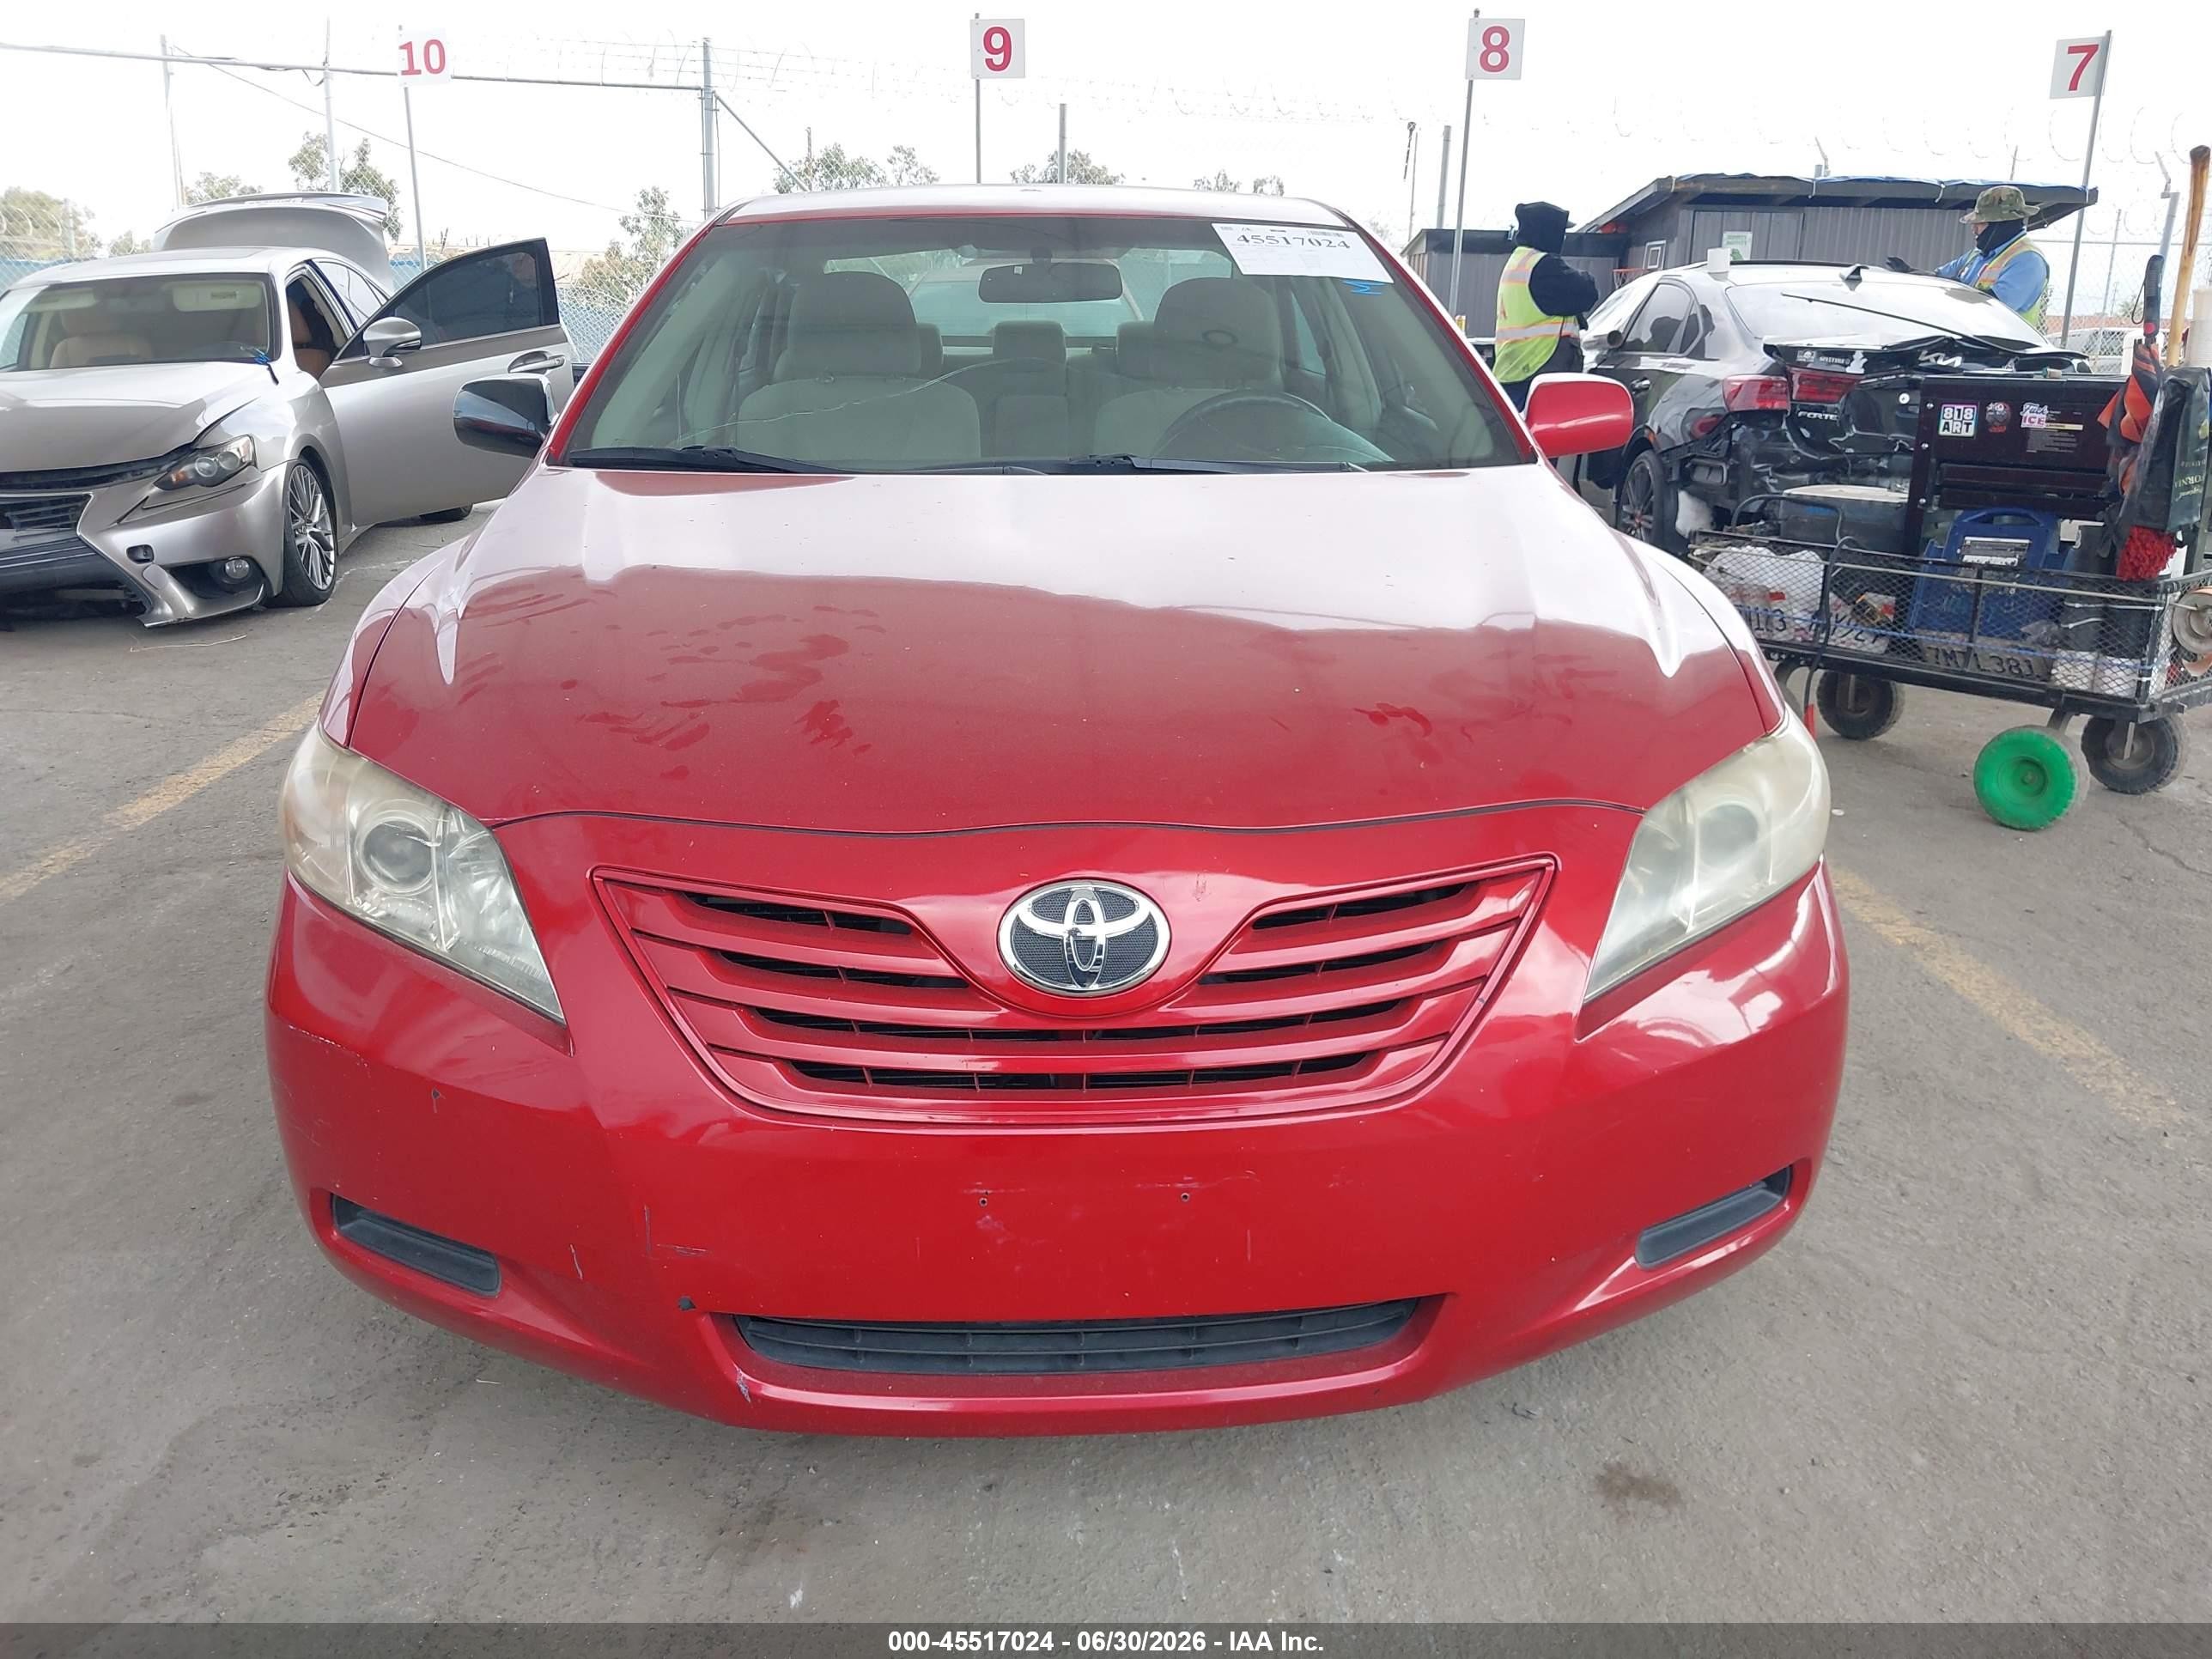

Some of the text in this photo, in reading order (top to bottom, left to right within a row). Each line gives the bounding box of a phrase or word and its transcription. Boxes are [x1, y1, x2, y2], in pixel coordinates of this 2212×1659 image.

[982, 26, 1012, 71] 9
[1480, 26, 1510, 72] 8
[398, 40, 446, 75] 10
[2068, 44, 2100, 91] 7
[1237, 234, 1351, 249] 45517024
[1797, 410, 1838, 421] FORTE
[1942, 406, 1973, 420] 818
[1942, 421, 1972, 434] ART
[2023, 416, 2045, 426] ICE
